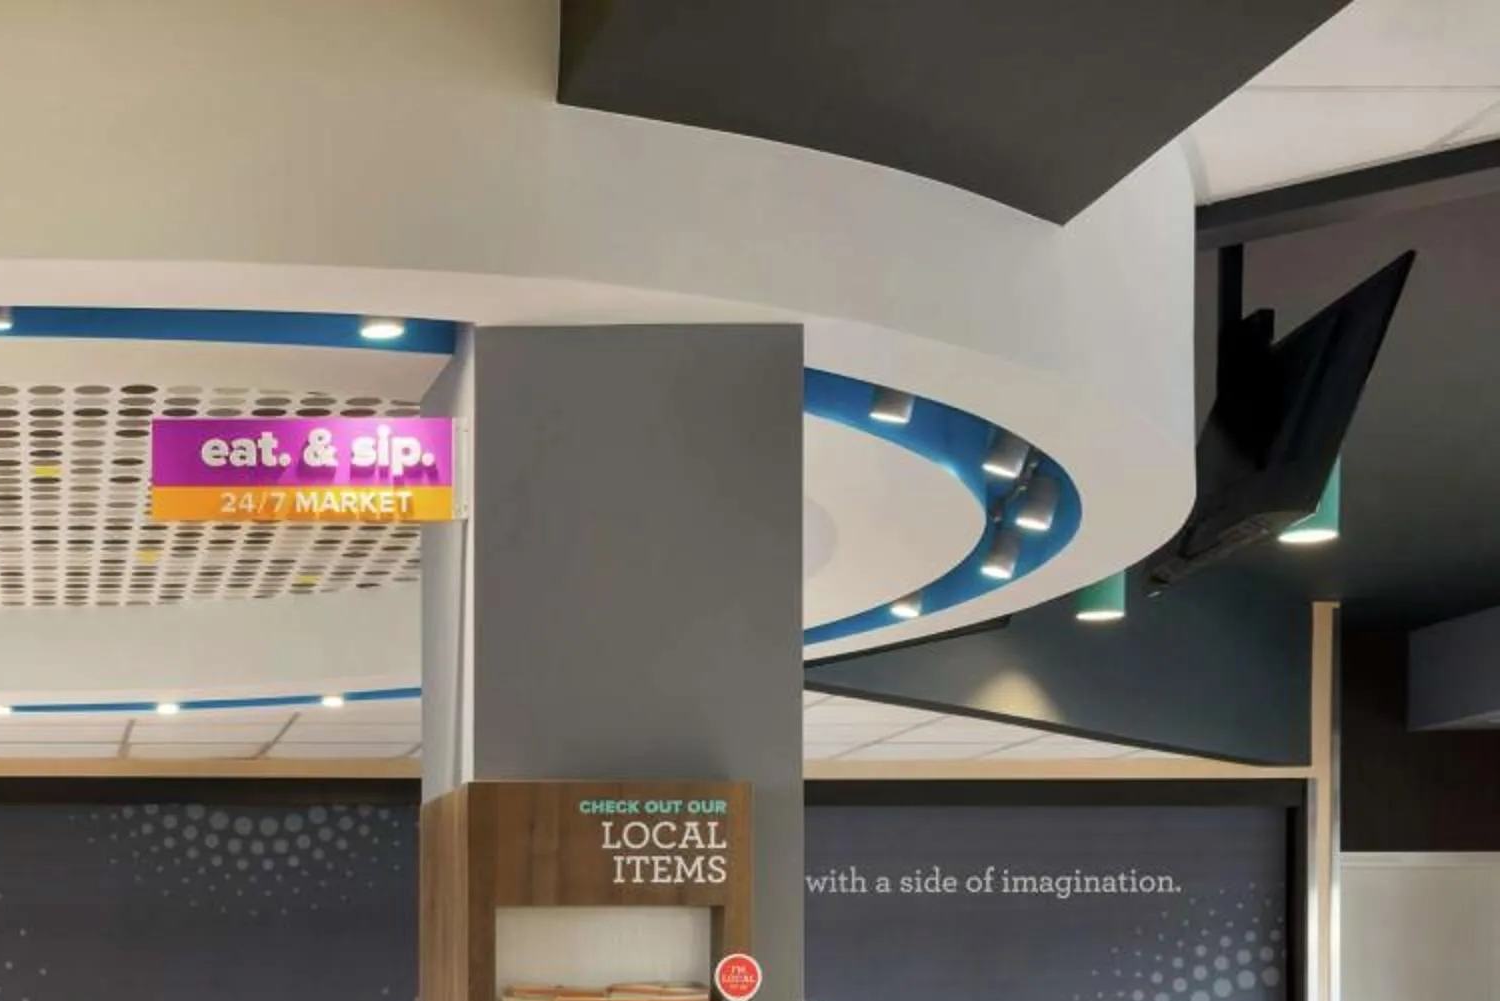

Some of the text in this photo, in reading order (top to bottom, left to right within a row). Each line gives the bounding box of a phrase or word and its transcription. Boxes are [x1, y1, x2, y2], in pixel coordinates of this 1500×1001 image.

[200, 423, 435, 478] eat. & sip.
[220, 491, 413, 513] 24/7 MARKET
[579, 800, 727, 814] CHECK OUT OUR
[601, 821, 727, 850] LOCAL
[613, 855, 727, 884] ITEMS
[805, 866, 1182, 899] with a side of imagination.
